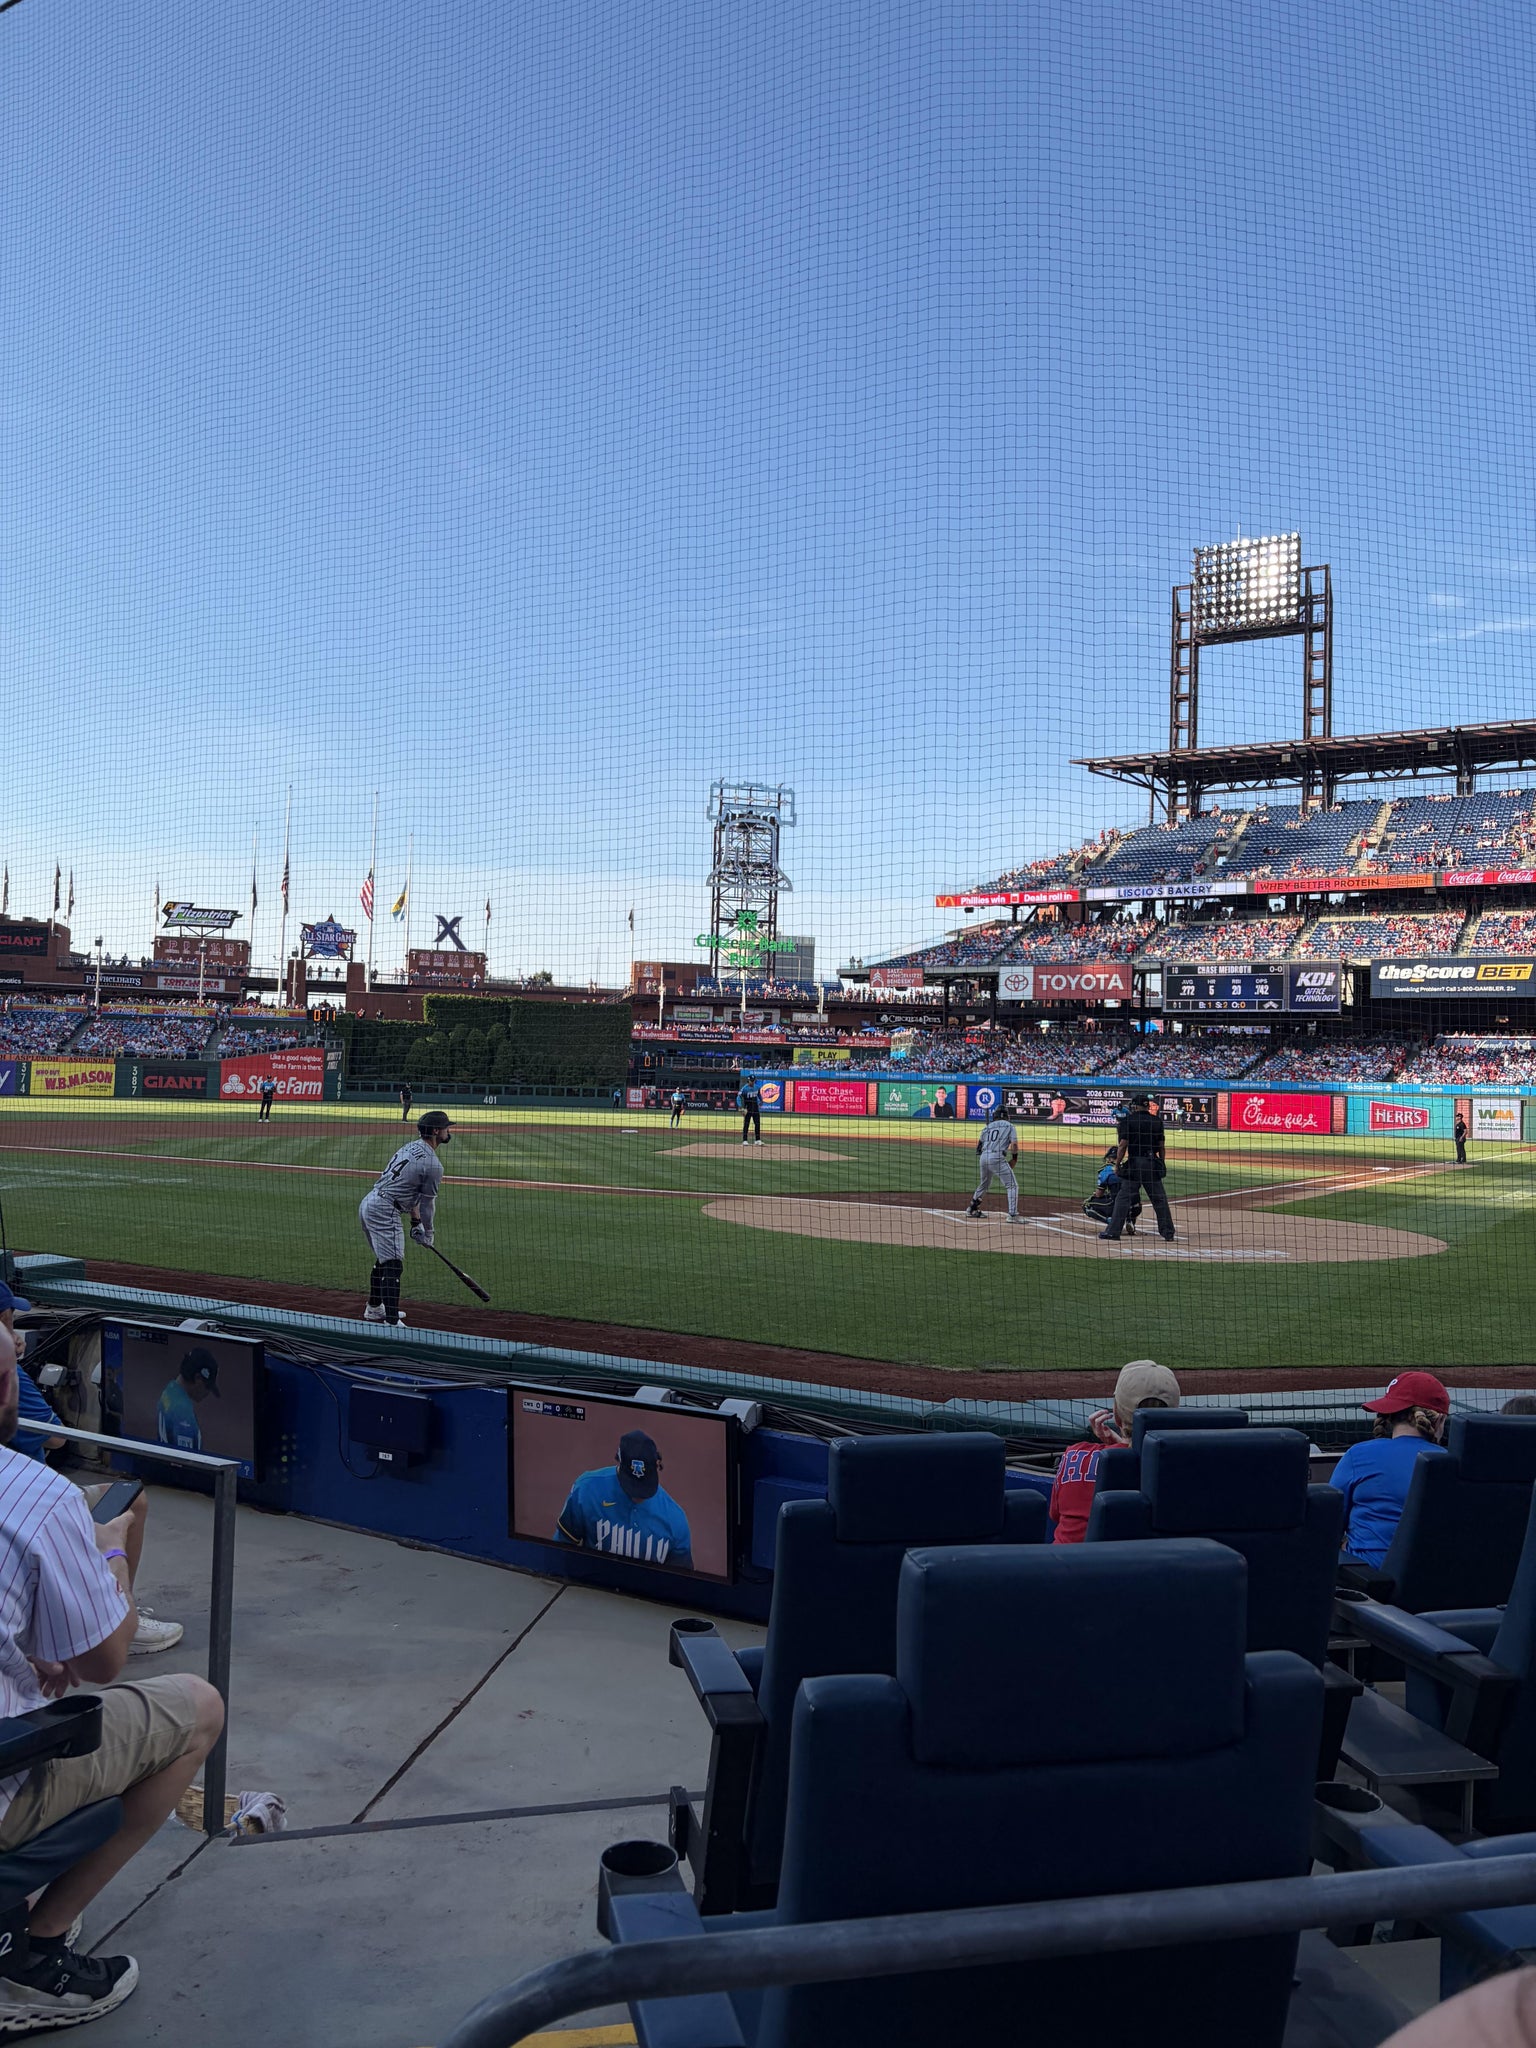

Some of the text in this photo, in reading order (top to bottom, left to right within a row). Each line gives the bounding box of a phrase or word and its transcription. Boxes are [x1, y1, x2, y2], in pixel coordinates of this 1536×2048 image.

[1450, 872, 1484, 884] Coca-Cola
[1498, 870, 1534, 882] Coca-Cola
[1260, 878, 1379, 891] WHEY BETTER PROTEIN
[1117, 885, 1213, 898] LISCIO'S BAKERY
[960, 897, 989, 905] Phillies
[991, 896, 1006, 904] win
[1024, 893, 1047, 902] Deals
[1049, 893, 1063, 901] roll
[170, 903, 234, 921] Fitzpatrick
[0, 936, 44, 946] GIANT
[336, 933, 357, 943] GAME
[696, 934, 797, 953] Citizens Bank
[729, 953, 762, 967] Park
[1197, 965, 1252, 974] CHASE MEIDROTH
[1378, 964, 1476, 980] theScore
[1482, 966, 1528, 978] BET
[1038, 973, 1124, 991] TOYOTA
[1296, 972, 1336, 987] KDI
[1208, 985, 1214, 996] 5
[1295, 994, 1336, 1002] TECHNOLOGY
[818, 1051, 837, 1059] PLAY
[143, 1075, 206, 1089] GIANT
[812, 1086, 853, 1096] Fox Chase
[483, 1096, 498, 1105] 401
[811, 1094, 863, 1103] Cancer Center
[1243, 1100, 1318, 1129] Chick-fil-A
[1375, 1108, 1422, 1125] HERR'S
[986, 1129, 1000, 1142] 10
[1386, 1378, 1398, 1394] P
